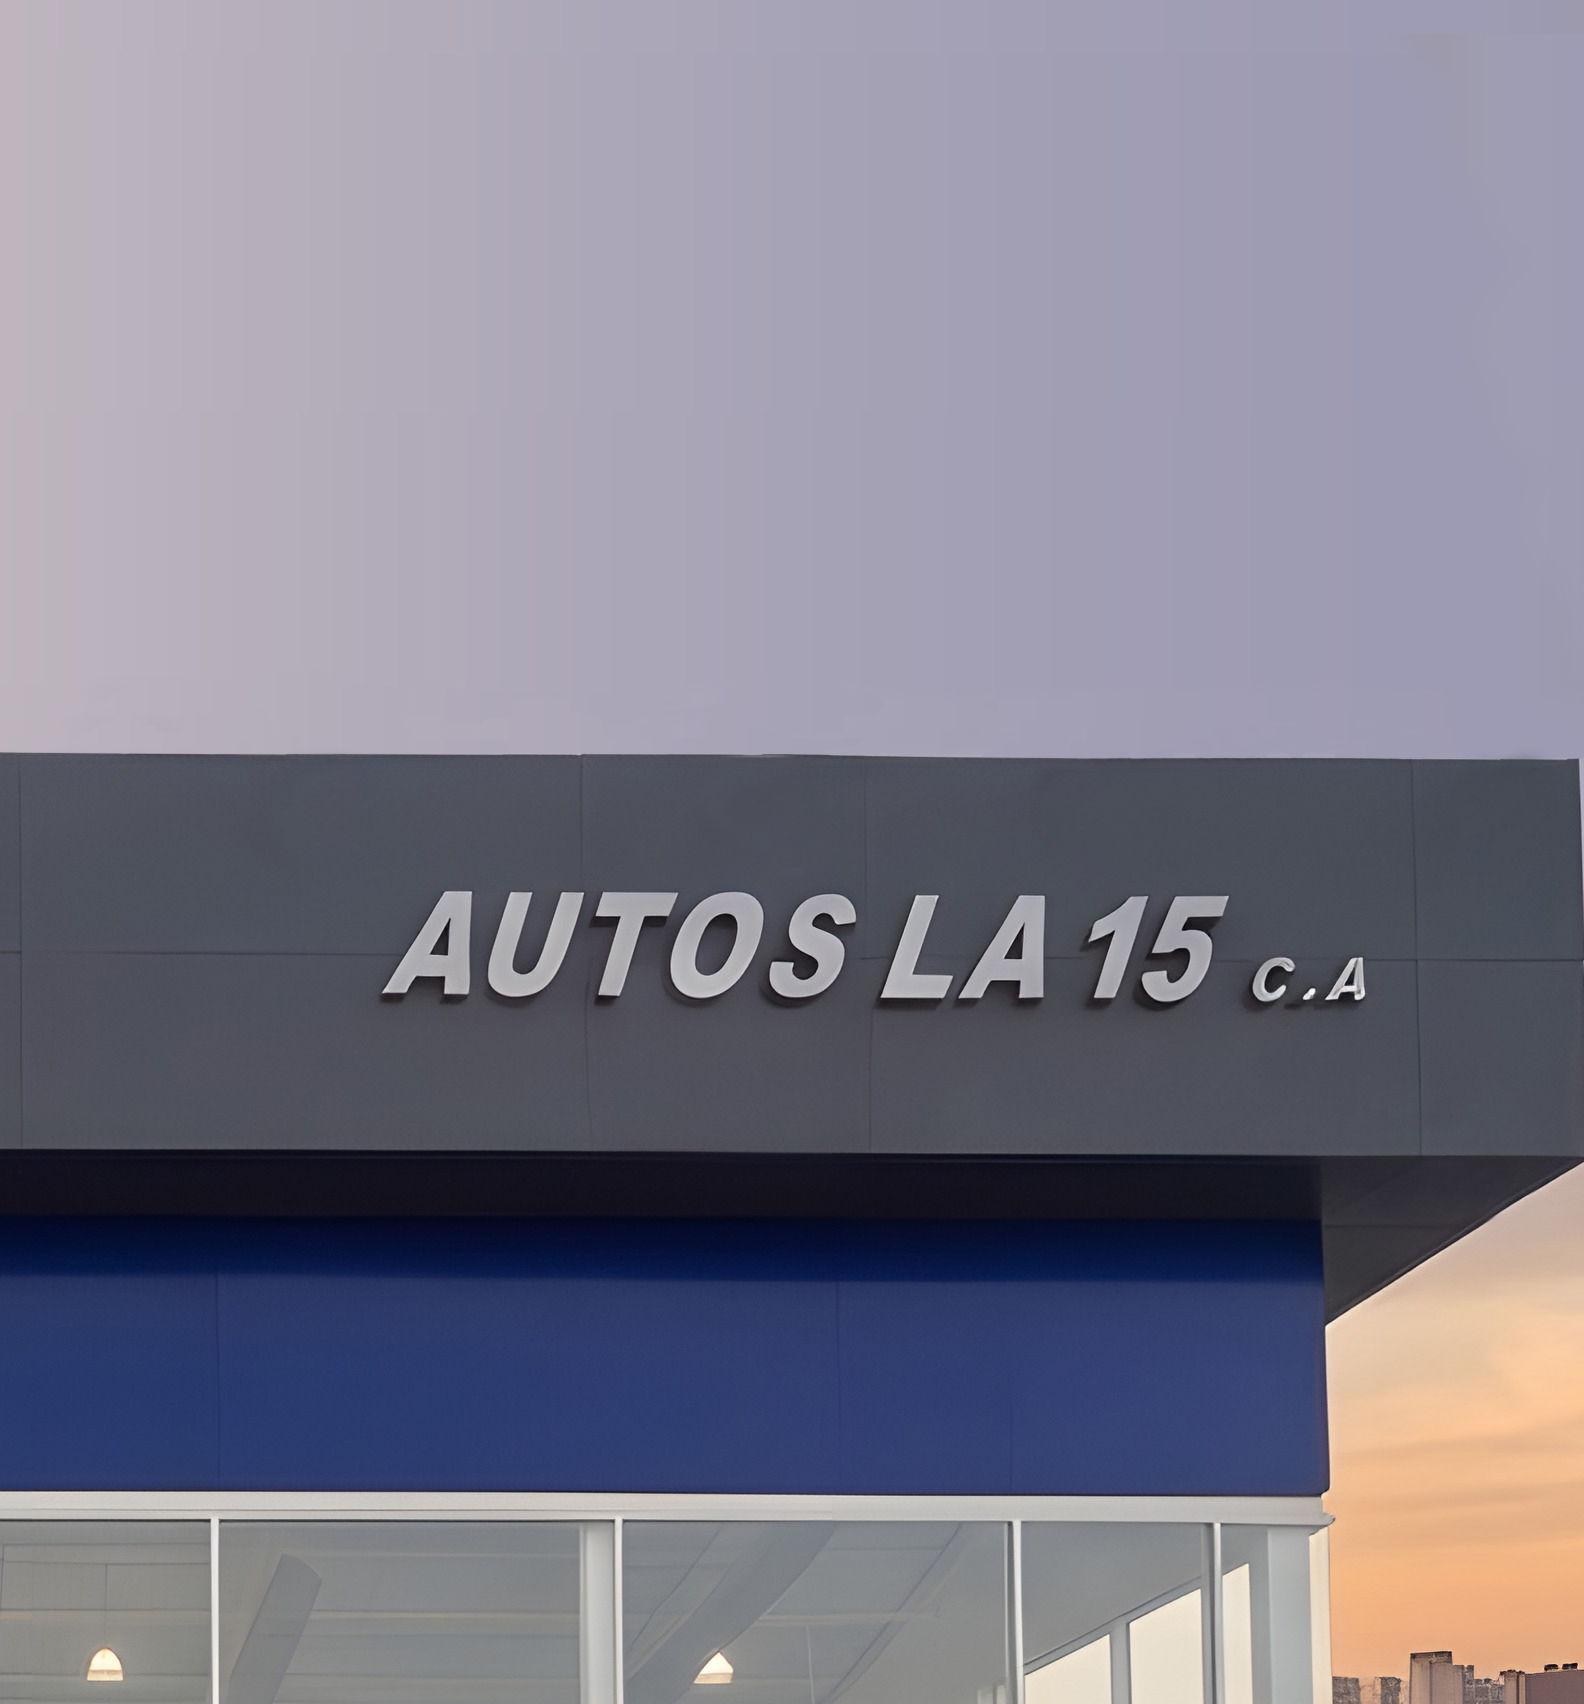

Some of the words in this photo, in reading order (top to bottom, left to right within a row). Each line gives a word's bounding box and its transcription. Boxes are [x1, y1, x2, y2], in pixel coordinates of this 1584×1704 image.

[382, 890, 857, 999] AUTOS
[880, 894, 1046, 999] LA
[1088, 895, 1230, 1002] 15
